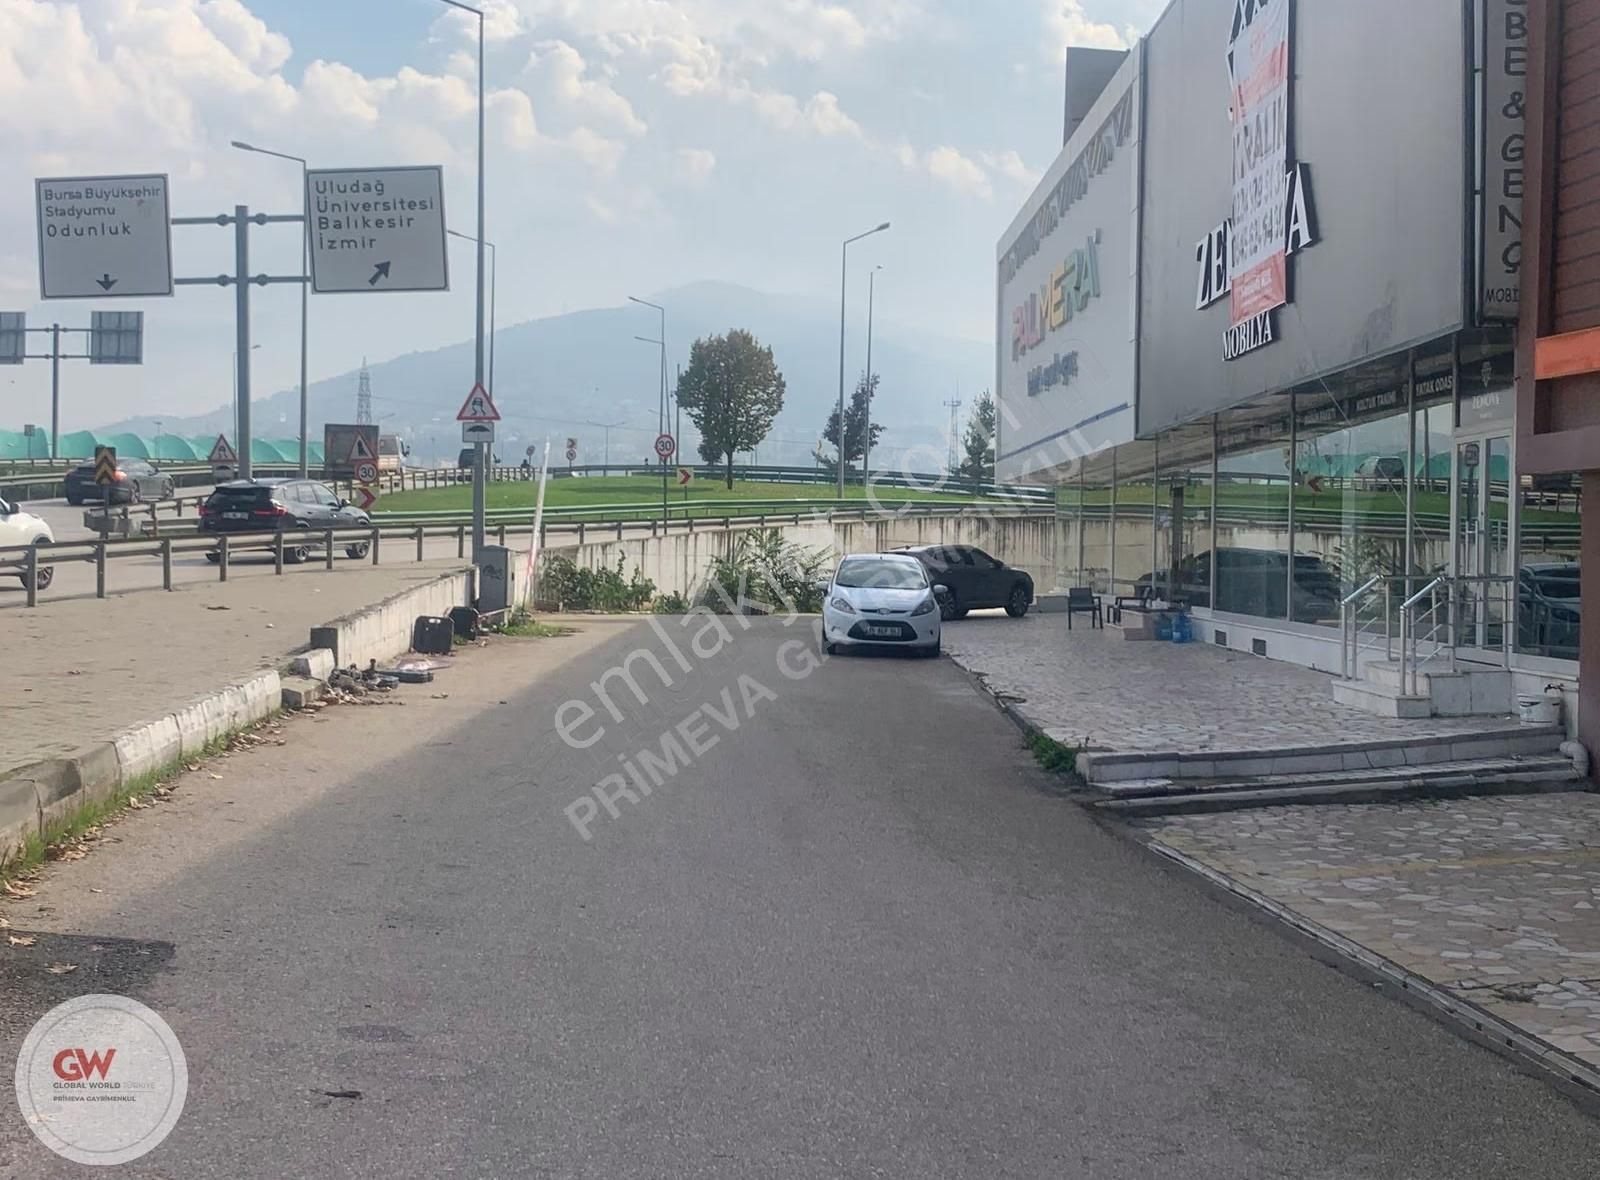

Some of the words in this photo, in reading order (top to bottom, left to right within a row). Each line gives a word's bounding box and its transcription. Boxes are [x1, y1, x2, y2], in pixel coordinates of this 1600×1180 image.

[1502, 91, 1526, 120] &
[44, 188, 82, 201] Bursa
[315, 179, 385, 196] Uludağ
[45, 204, 116, 219] Stadyumu
[316, 196, 434, 214] Üniversitesi
[46, 221, 131, 238] Odunluk
[318, 215, 415, 230] Balıkesir
[319, 232, 377, 250] İzmir
[1196, 163, 1312, 310] ZEA
[1435, 375, 1452, 393] ODAS
[658, 440, 672, 451] 30
[360, 466, 375, 479] 30
